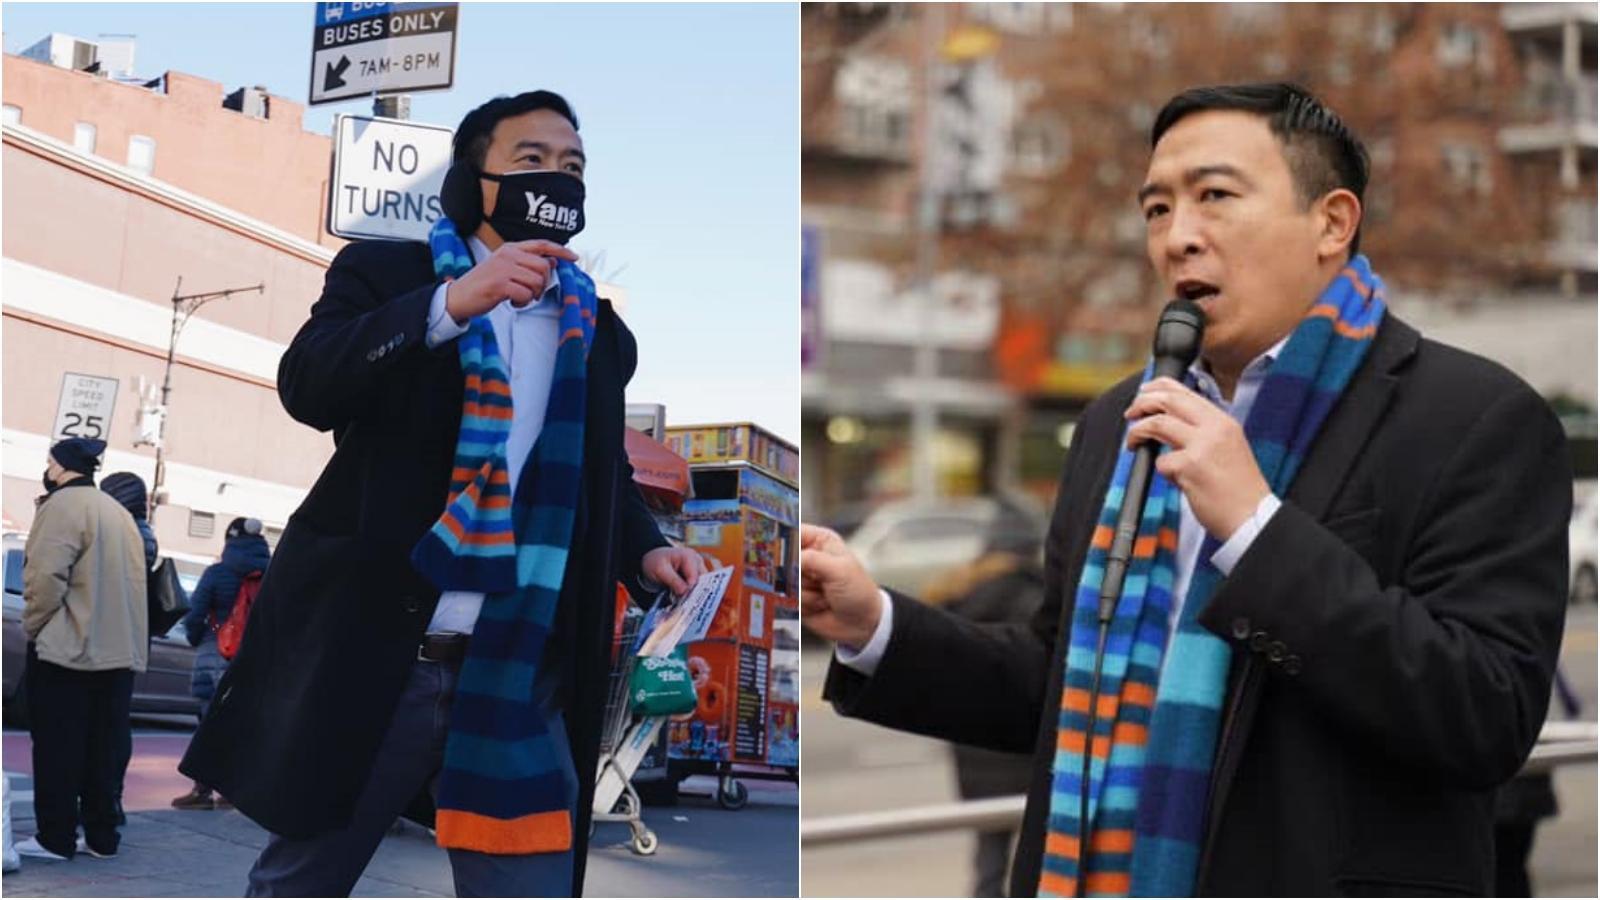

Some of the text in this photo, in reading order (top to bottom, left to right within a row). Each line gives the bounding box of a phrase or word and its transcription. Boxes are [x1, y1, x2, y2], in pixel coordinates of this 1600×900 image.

[323, 11, 445, 46] BUSES ONLY
[373, 140, 418, 175] NO
[344, 184, 442, 223] TURNS
[524, 191, 578, 231] Yang
[72, 388, 104, 401] SPEED
[78, 379, 101, 388] CITY
[72, 400, 99, 410] LIMIT
[61, 412, 103, 439] 25
